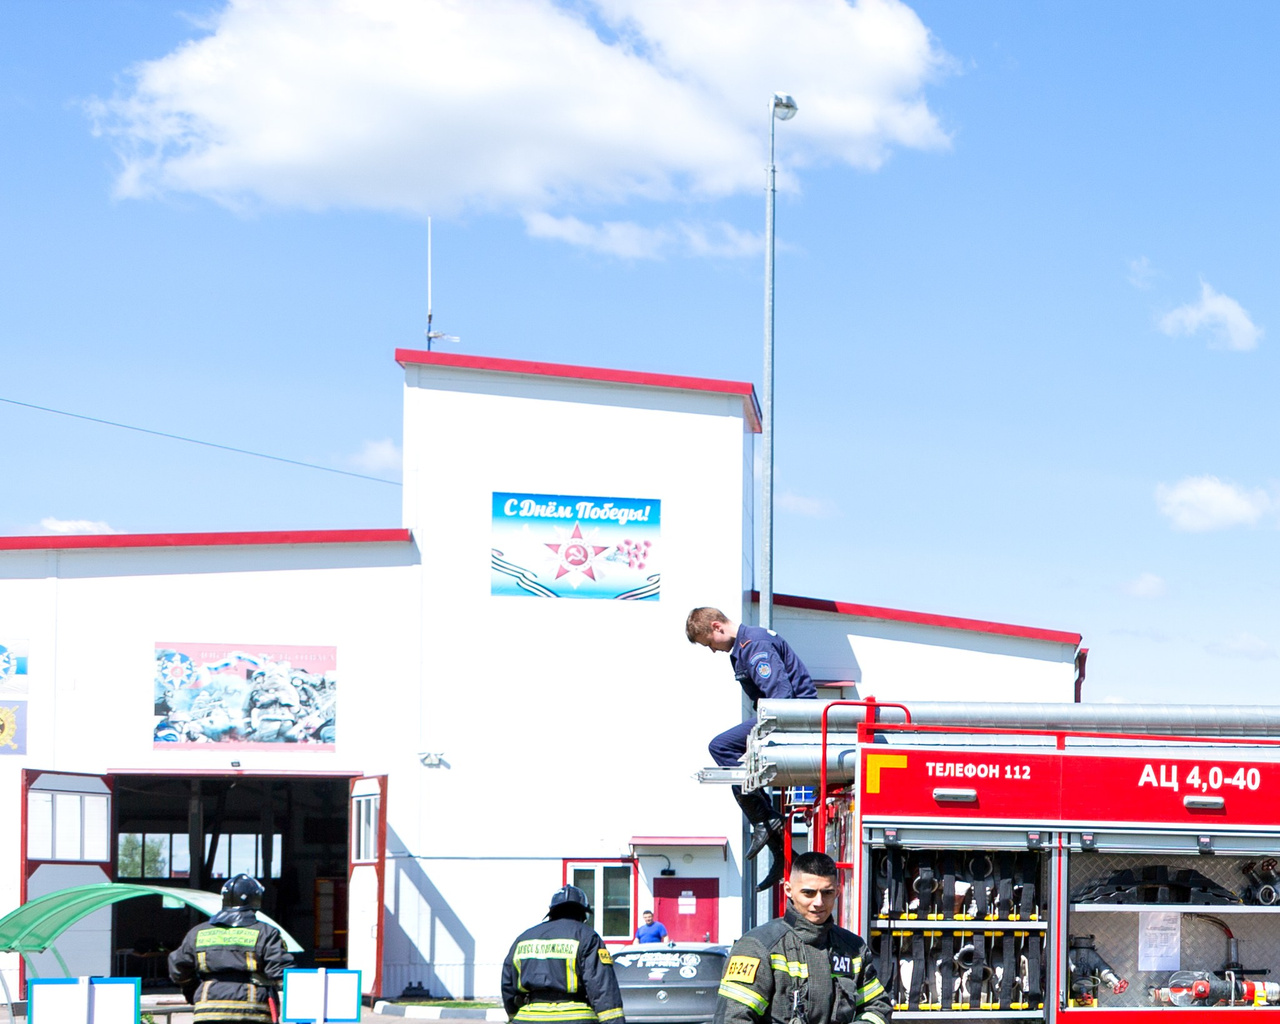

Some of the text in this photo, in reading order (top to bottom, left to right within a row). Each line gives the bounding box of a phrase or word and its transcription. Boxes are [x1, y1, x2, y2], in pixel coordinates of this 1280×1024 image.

[504, 498, 651, 525] С Днём Победы!
[926, 762, 1031, 780] ТЕЛЕФОН 112
[1138, 764, 1261, 793] АЦ 4,0-40
[833, 956, 851, 972] 247
